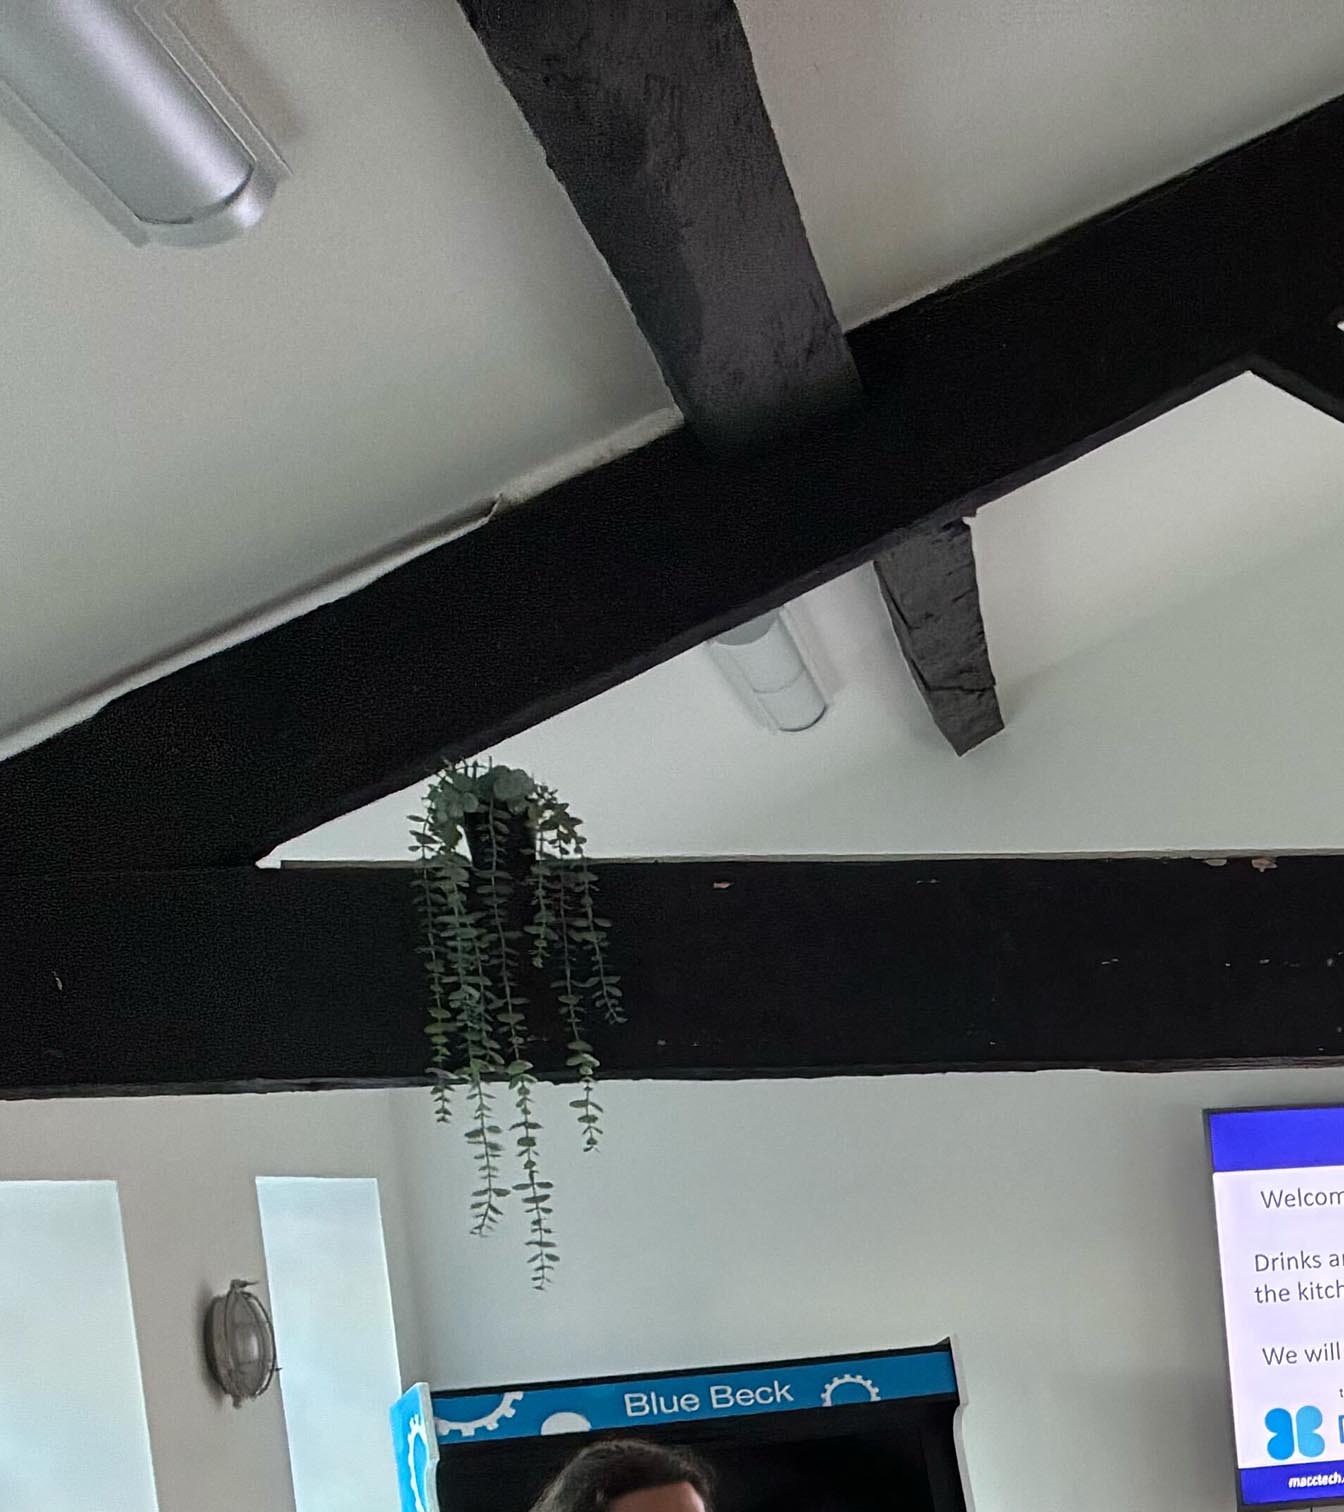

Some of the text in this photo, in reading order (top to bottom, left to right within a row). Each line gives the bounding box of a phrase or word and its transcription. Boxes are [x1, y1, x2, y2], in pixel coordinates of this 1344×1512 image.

[1255, 1250, 1322, 1273] Drinks
[1254, 1283, 1290, 1305] the
[1262, 1345, 1297, 1366] We
[1304, 1342, 1341, 1364] will
[624, 1380, 794, 1417] Blue Beck
